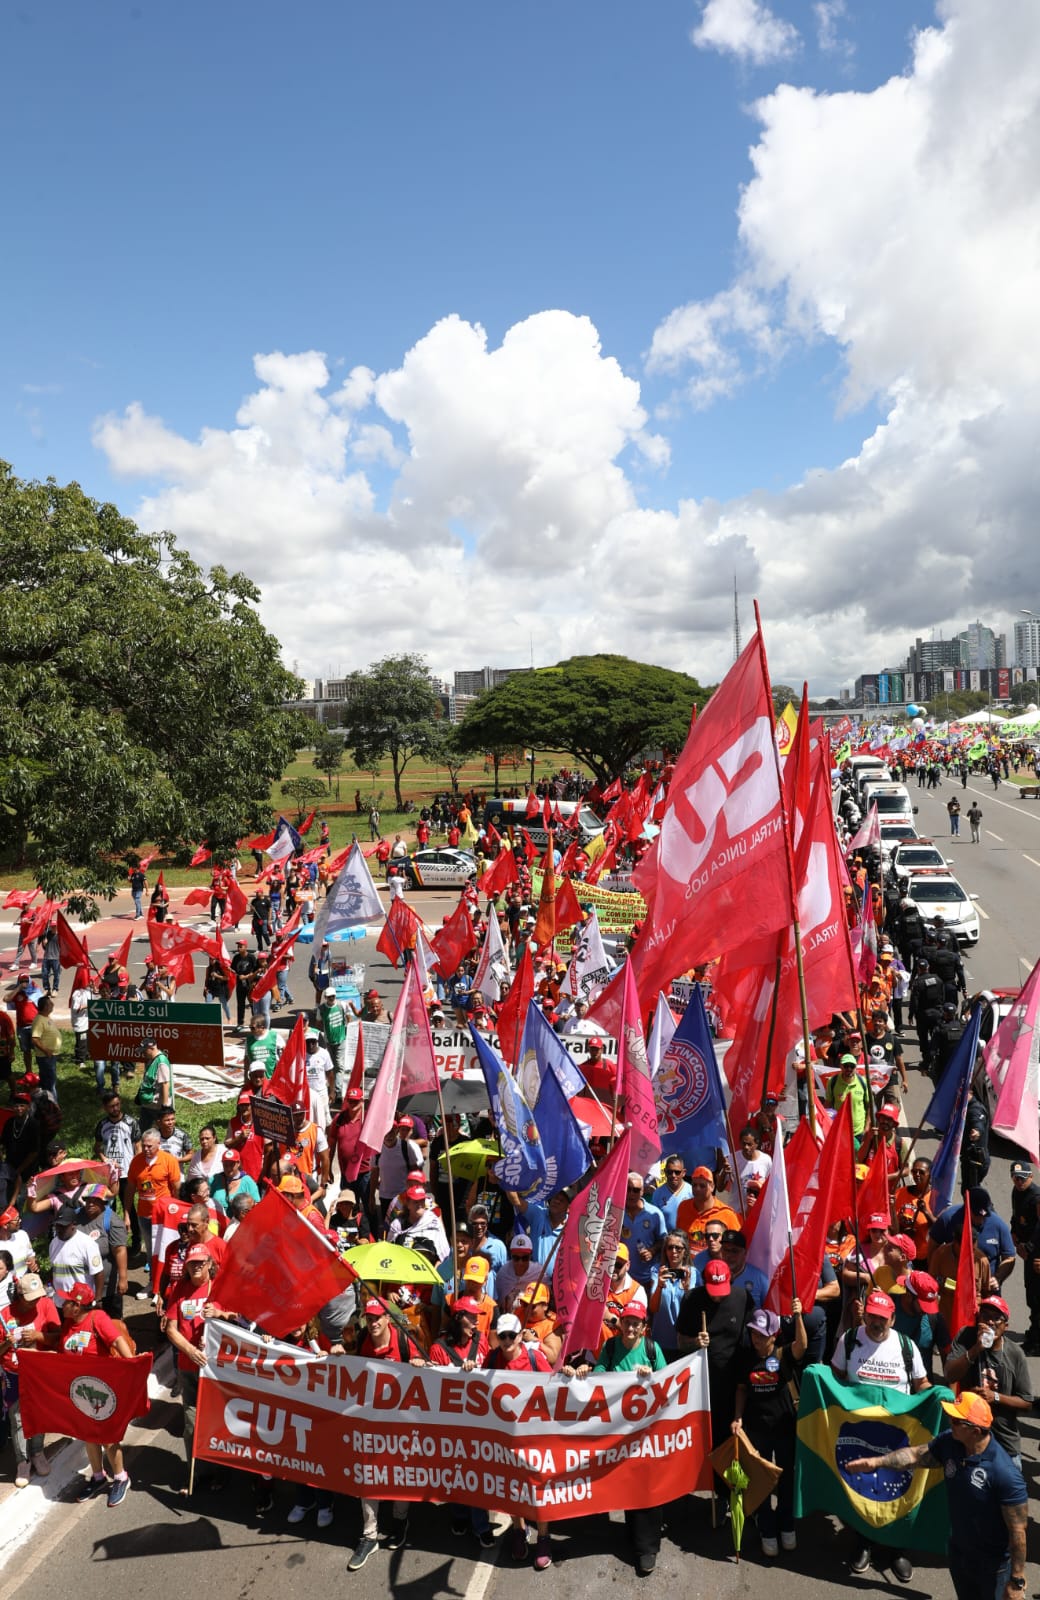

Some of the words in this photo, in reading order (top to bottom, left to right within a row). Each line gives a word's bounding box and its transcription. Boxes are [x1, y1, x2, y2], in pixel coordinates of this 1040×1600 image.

[105, 1002, 126, 1016] Via
[129, 1003, 145, 1017] L2
[148, 1003, 168, 1017] sul
[106, 1022, 179, 1039] Ministérios
[216, 1333, 302, 1386] PELO
[306, 1361, 369, 1407] FIM
[372, 1372, 431, 1412] DA
[439, 1377, 611, 1424] ESCALA
[621, 1366, 692, 1422] 6X1
[223, 1397, 313, 1454] CUT
[208, 1436, 252, 1459] SANTA
[255, 1450, 326, 1477] CATARINA
[352, 1429, 436, 1462] REDUÇÃO
[440, 1437, 467, 1459] DA
[470, 1439, 556, 1474] JORNADA
[566, 1449, 591, 1472] DE
[594, 1425, 693, 1466] TRABALHO!
[353, 1464, 389, 1486] SEM
[393, 1463, 478, 1496] REDUÇÃO
[483, 1473, 505, 1499] DE
[509, 1476, 592, 1507] SALÁRIO!
